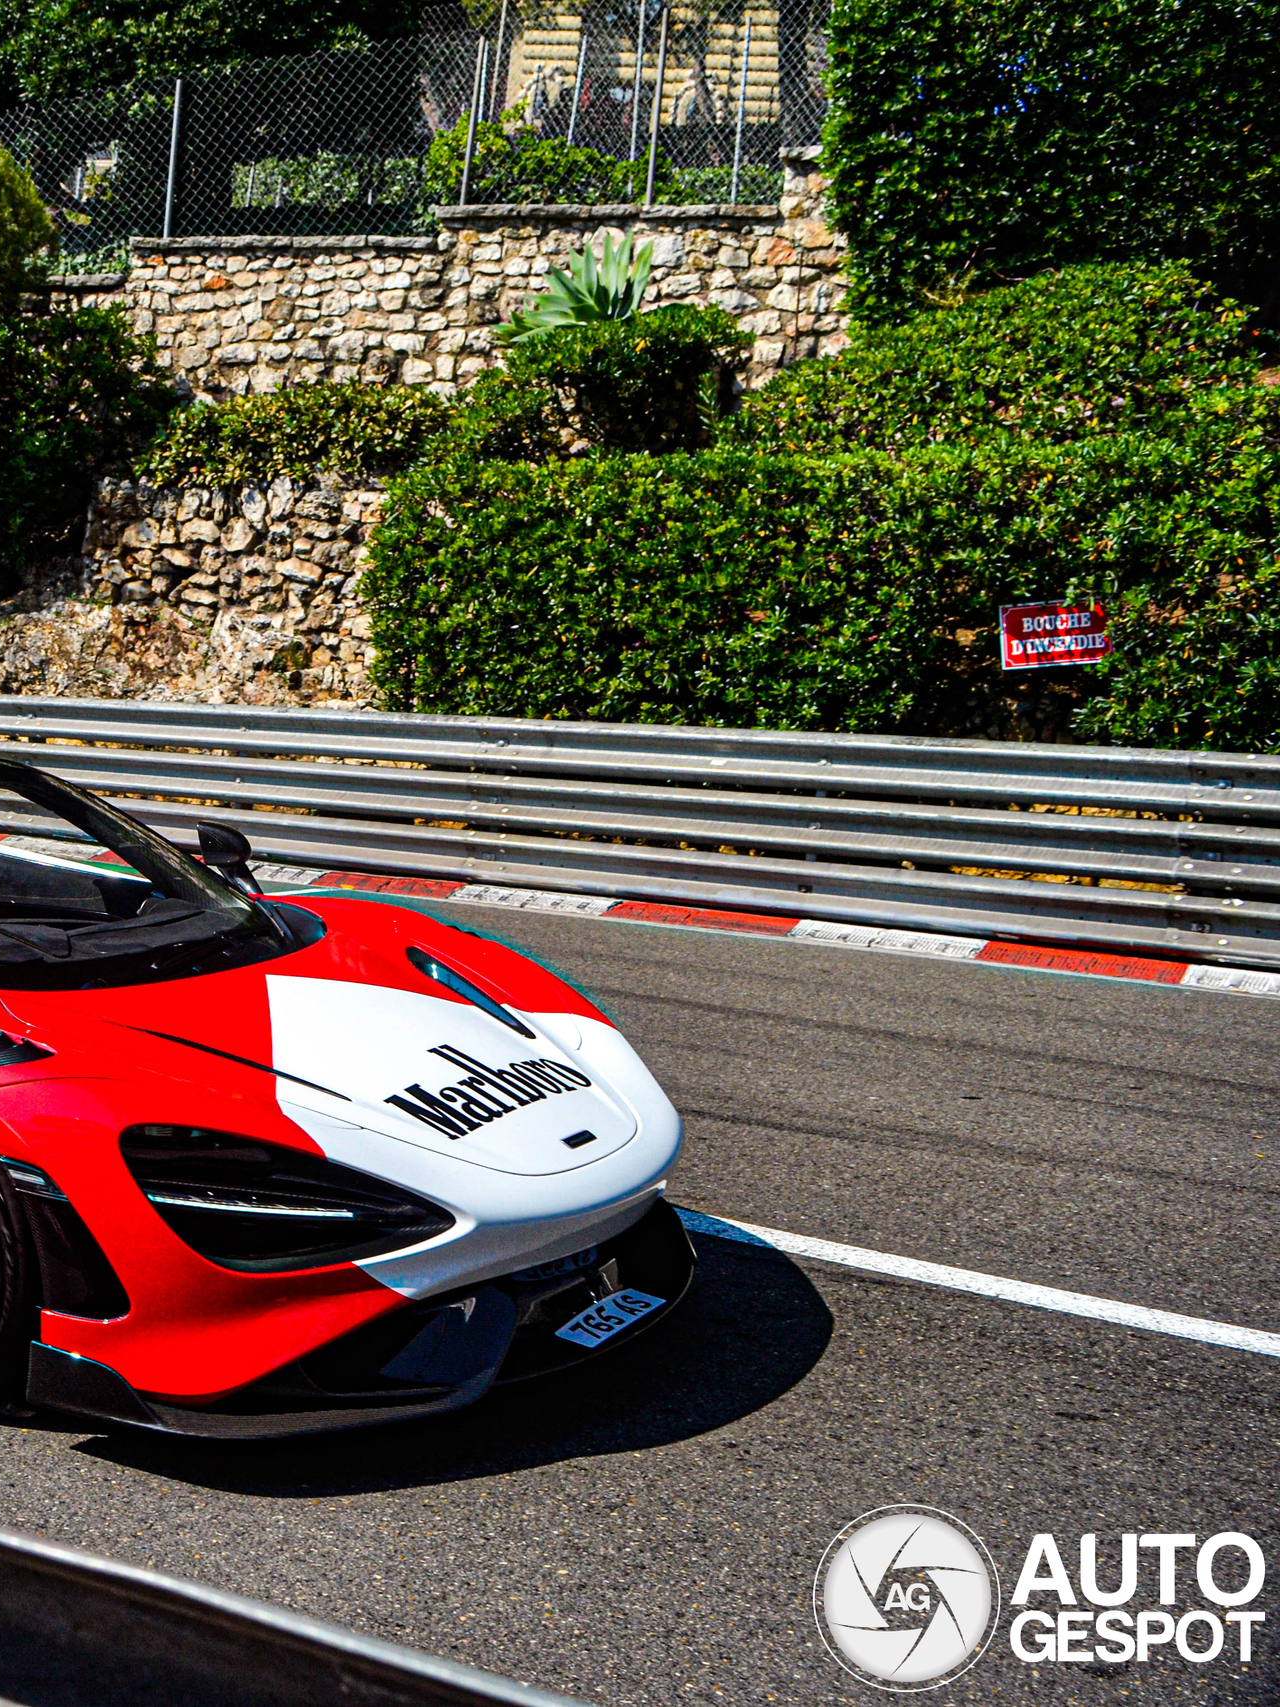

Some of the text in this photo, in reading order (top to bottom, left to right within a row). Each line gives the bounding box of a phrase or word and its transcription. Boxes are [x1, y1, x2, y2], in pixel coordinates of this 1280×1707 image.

[1022, 612, 1091, 632] BOUCHE
[1011, 633, 1105, 655] D'INCENDIE
[383, 1044, 592, 1140] Marlboro
[568, 1294, 652, 1339] 765 AS
